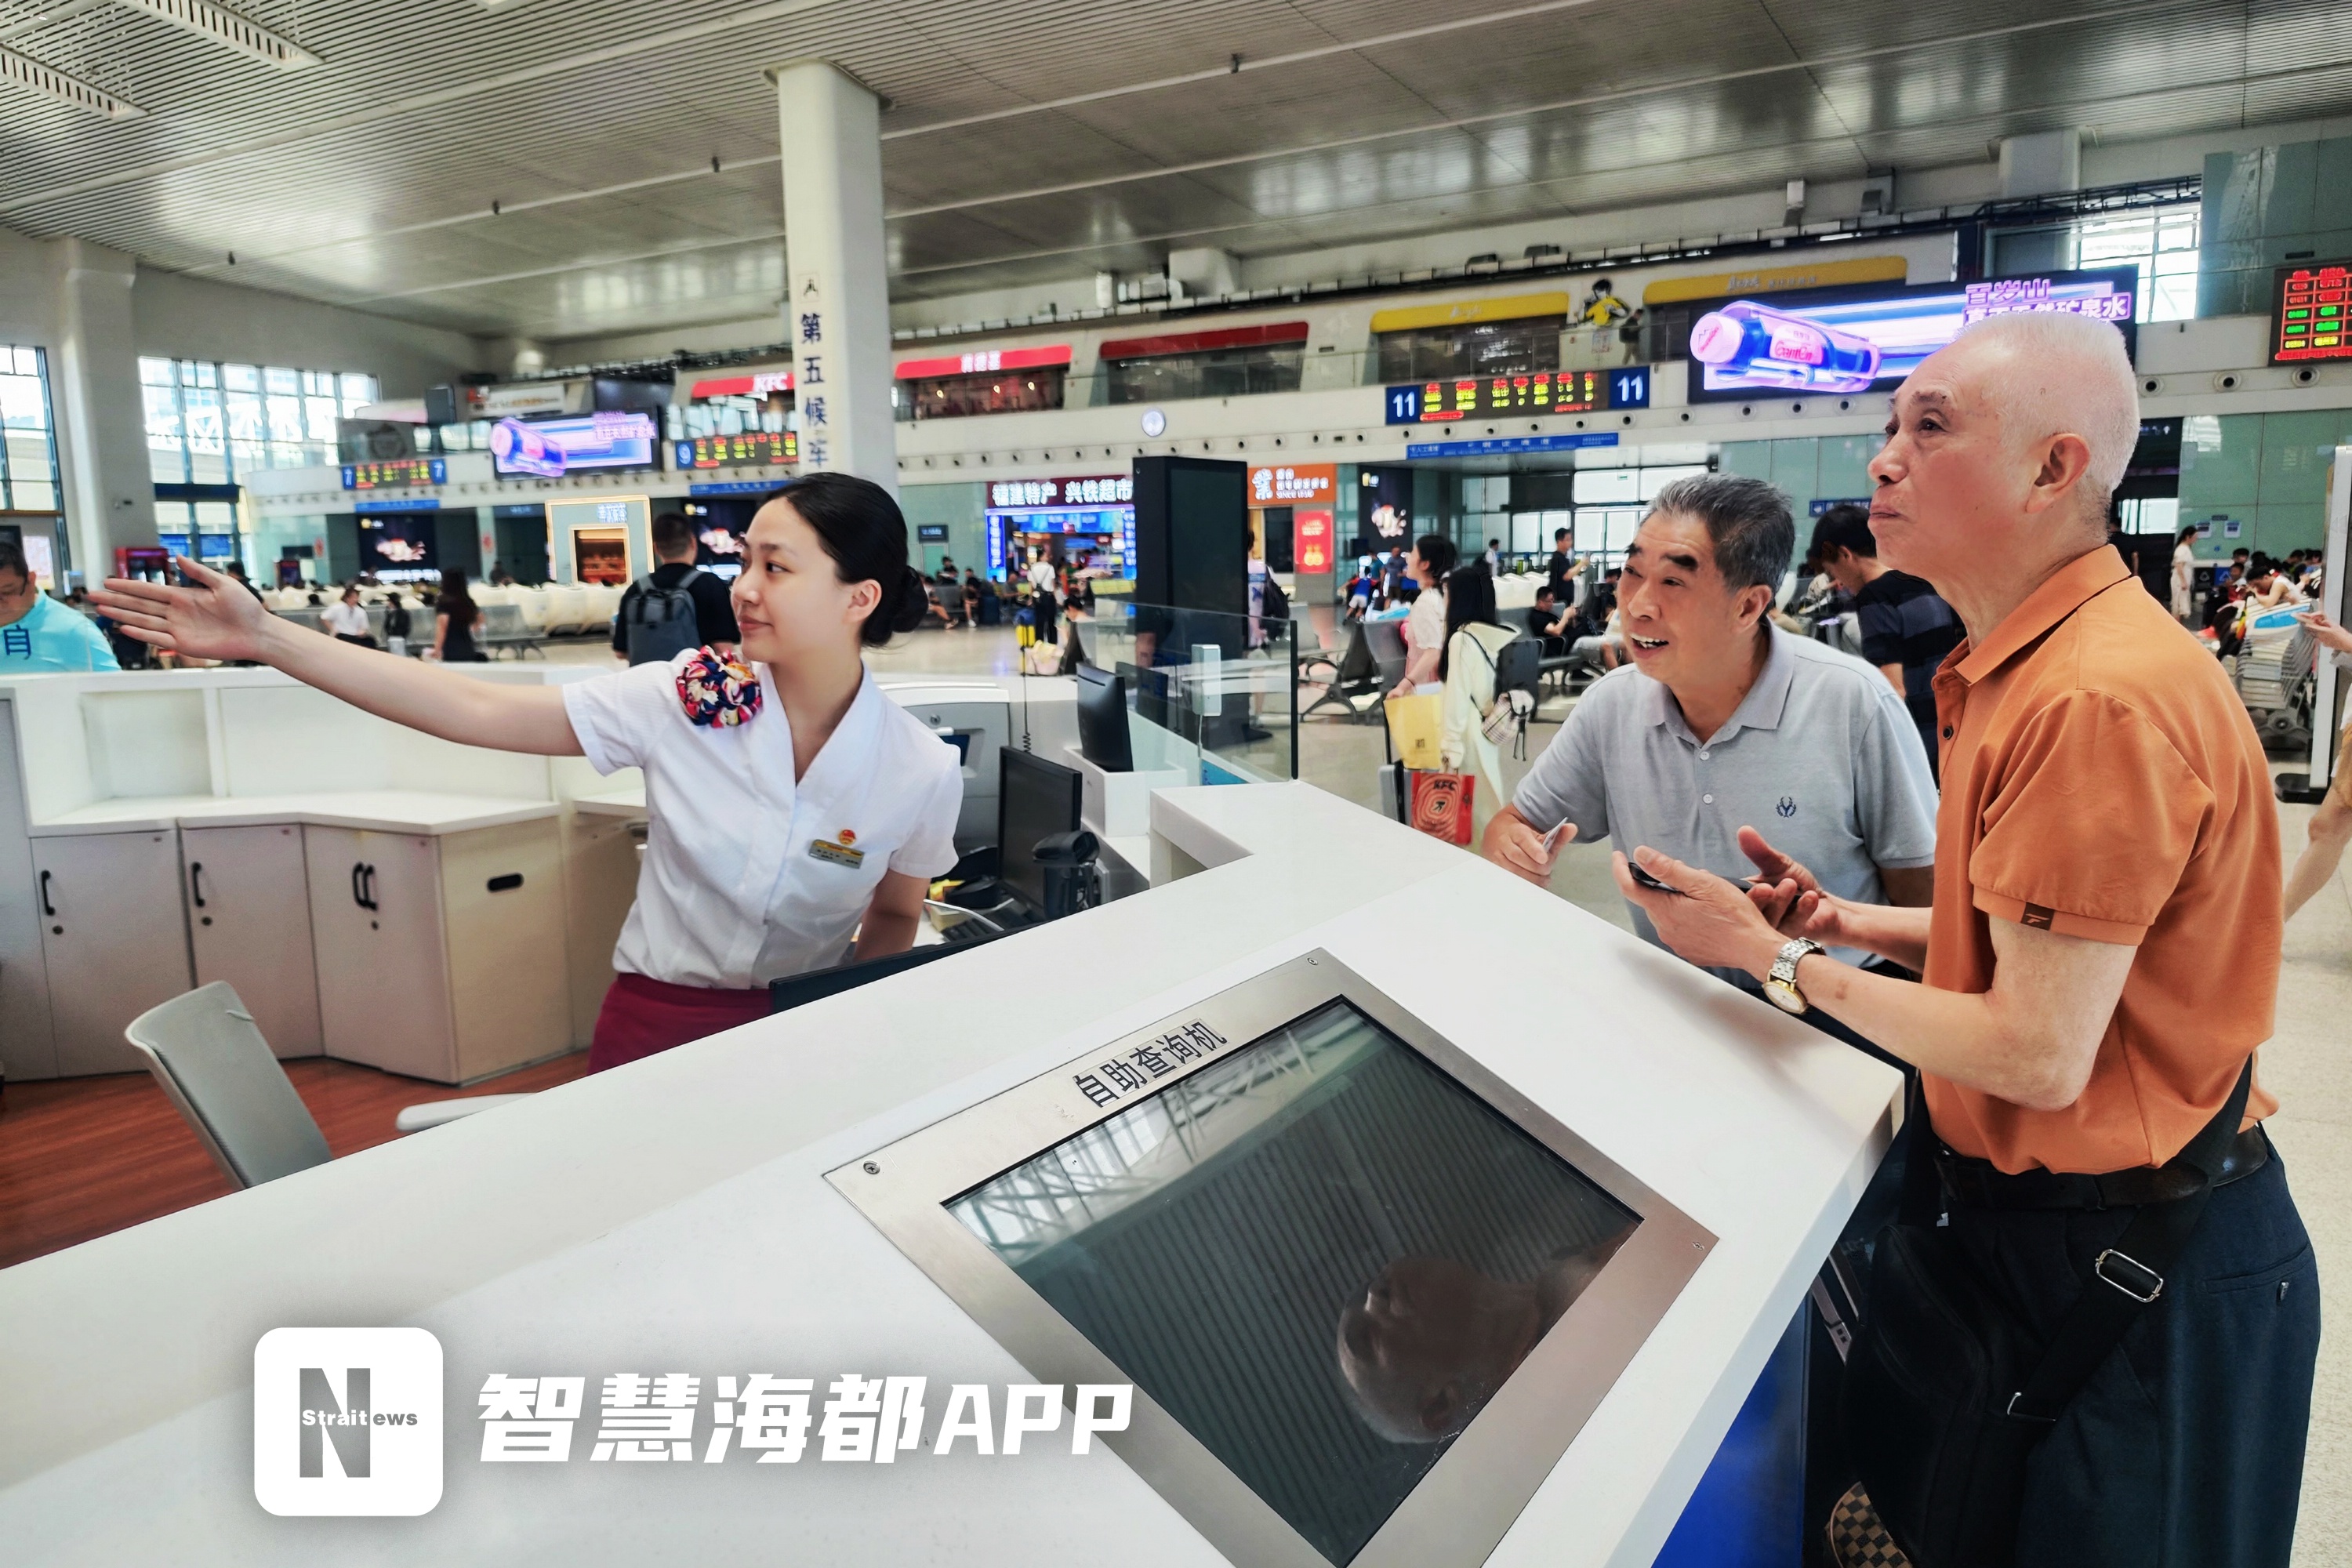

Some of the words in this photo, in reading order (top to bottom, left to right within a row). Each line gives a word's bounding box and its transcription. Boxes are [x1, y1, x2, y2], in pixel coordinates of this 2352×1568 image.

[1965, 278, 2050, 307] 百岁山
[753, 372, 788, 392] KFC
[1617, 374, 1644, 401] 11
[1392, 391, 1415, 418] 11
[992, 481, 1058, 506] 福建特产
[1065, 478, 1133, 503] 兴铁超市
[1433, 779, 1457, 791] KFC
[1073, 1022, 1228, 1108] 自助查询机
